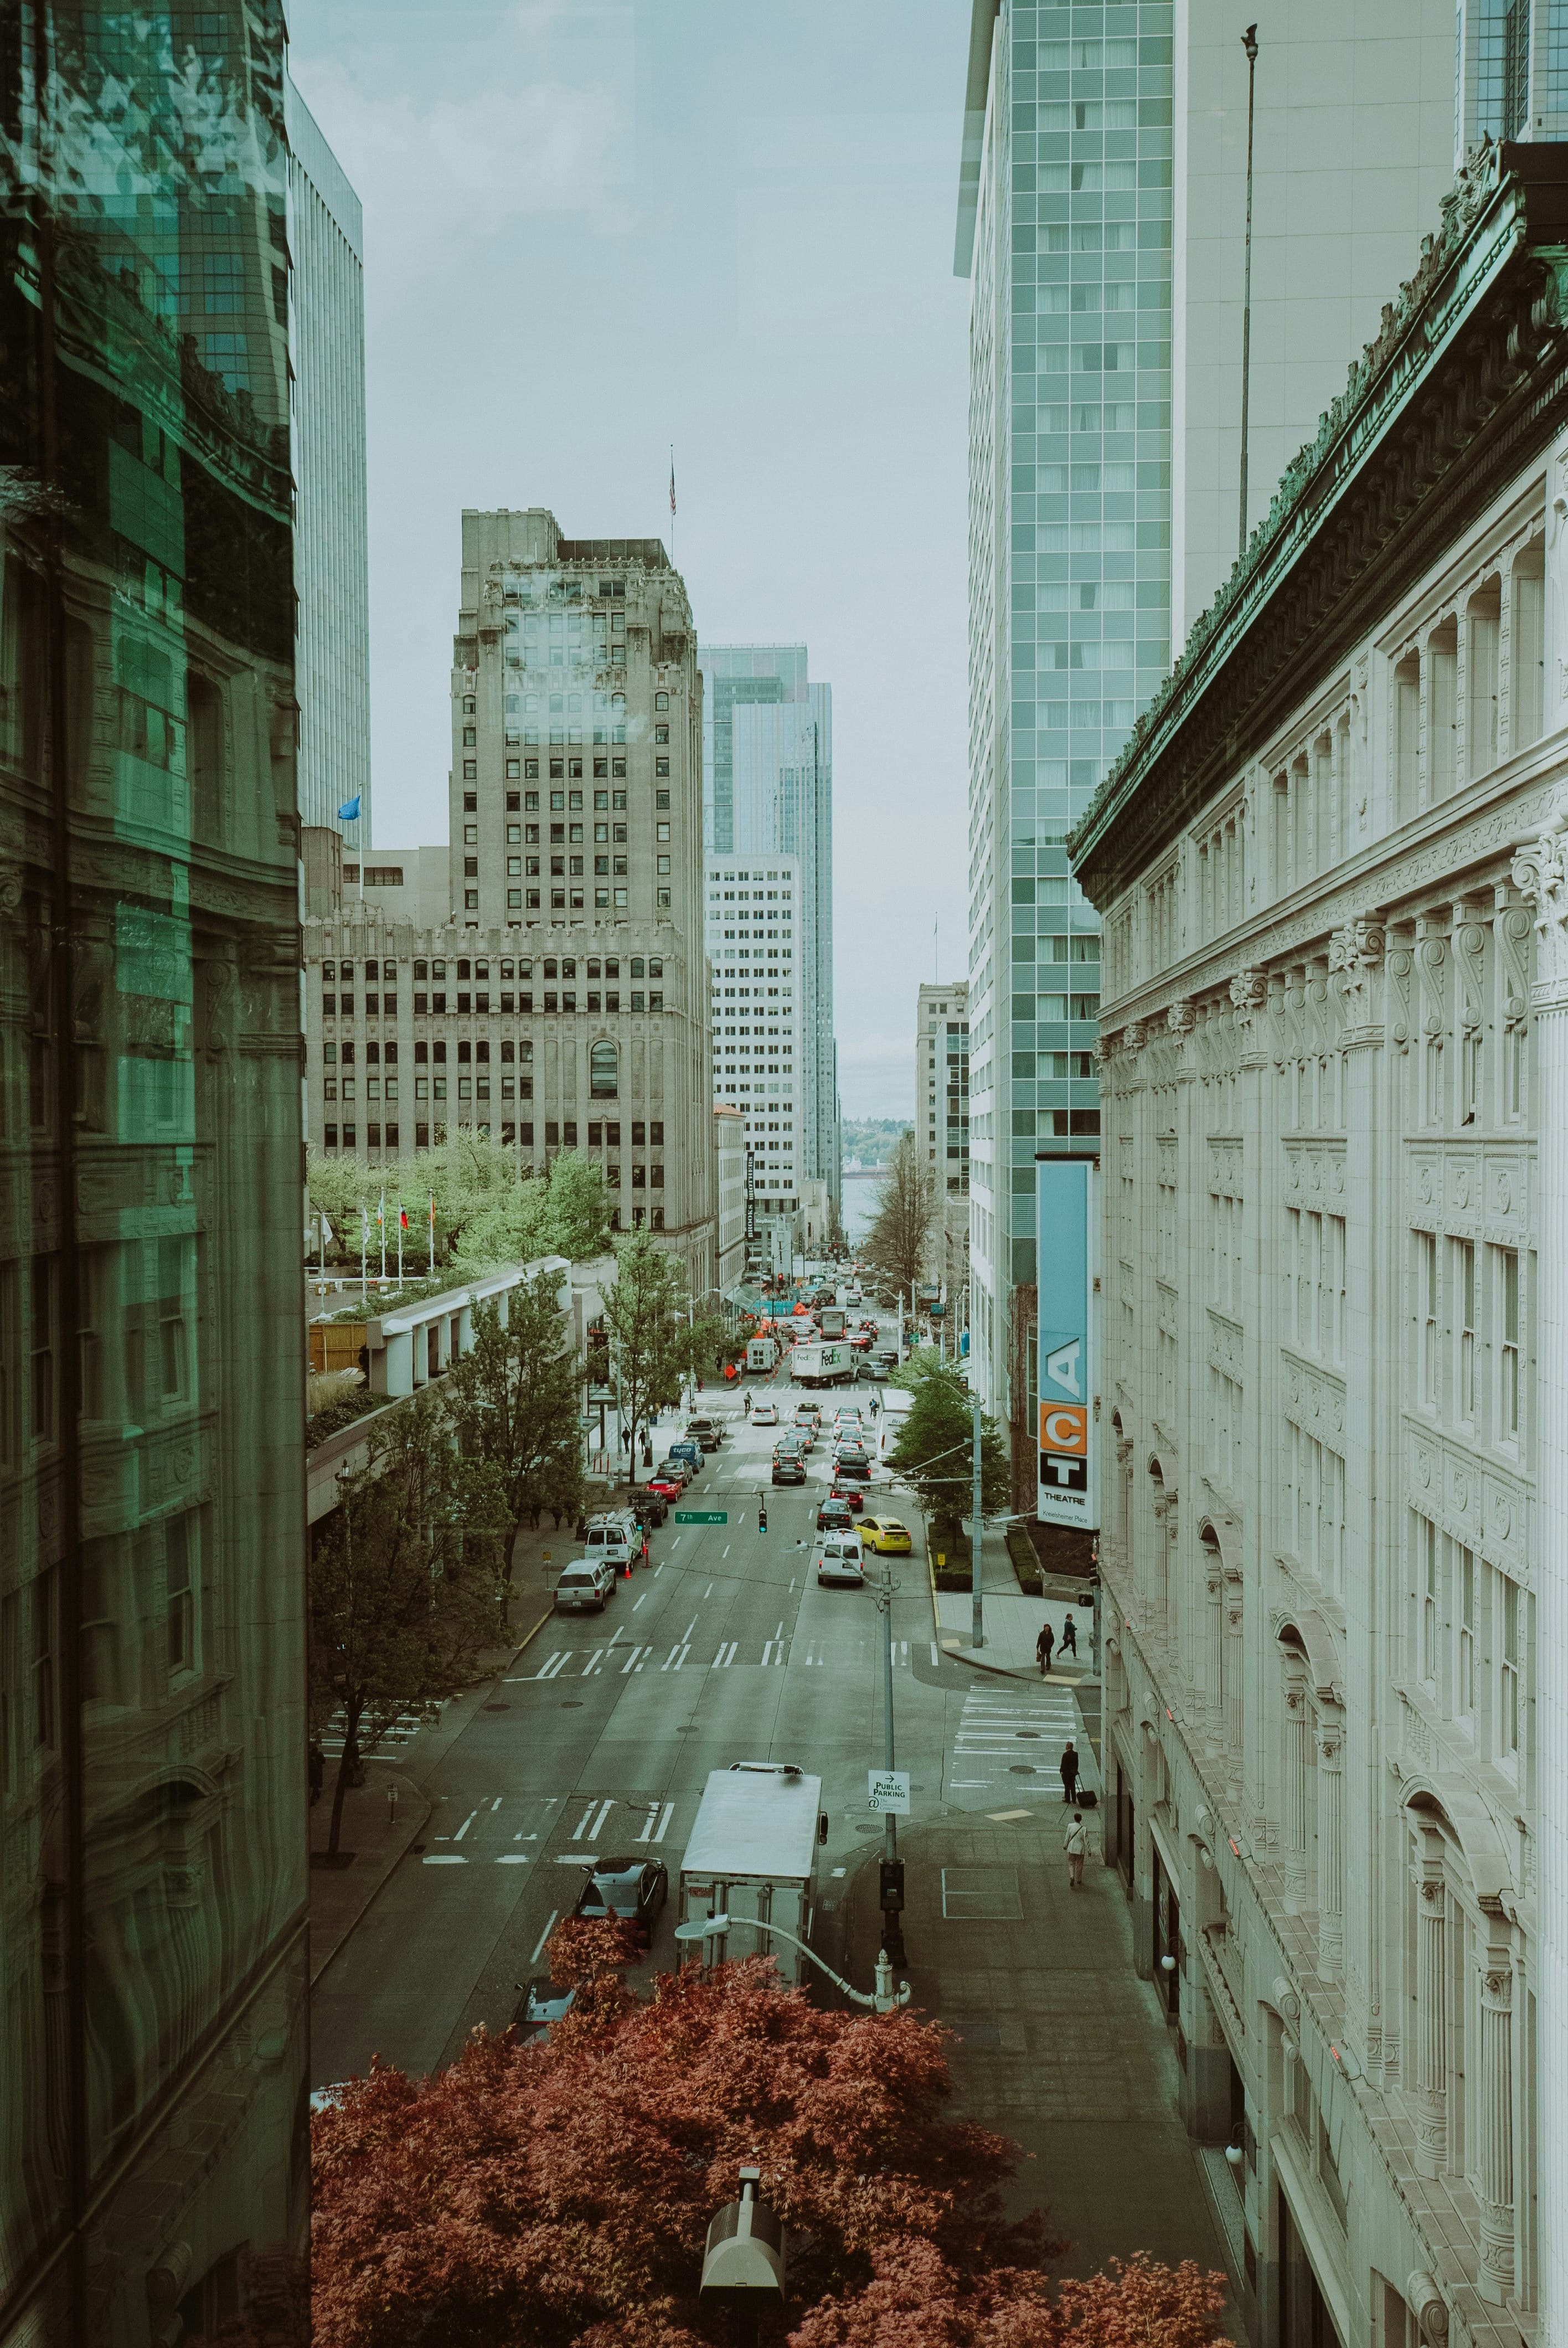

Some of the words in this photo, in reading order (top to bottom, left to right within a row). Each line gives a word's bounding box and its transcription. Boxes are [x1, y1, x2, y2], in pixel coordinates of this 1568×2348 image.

[822, 1348, 841, 1366] FedEx
[1044, 1492, 1085, 1506] THEATRE
[680, 1513, 693, 1522] 7th
[1075, 1515, 1087, 1523] Place
[876, 1781, 902, 1791] PUBLIC
[873, 1788, 905, 1798] PARKING
